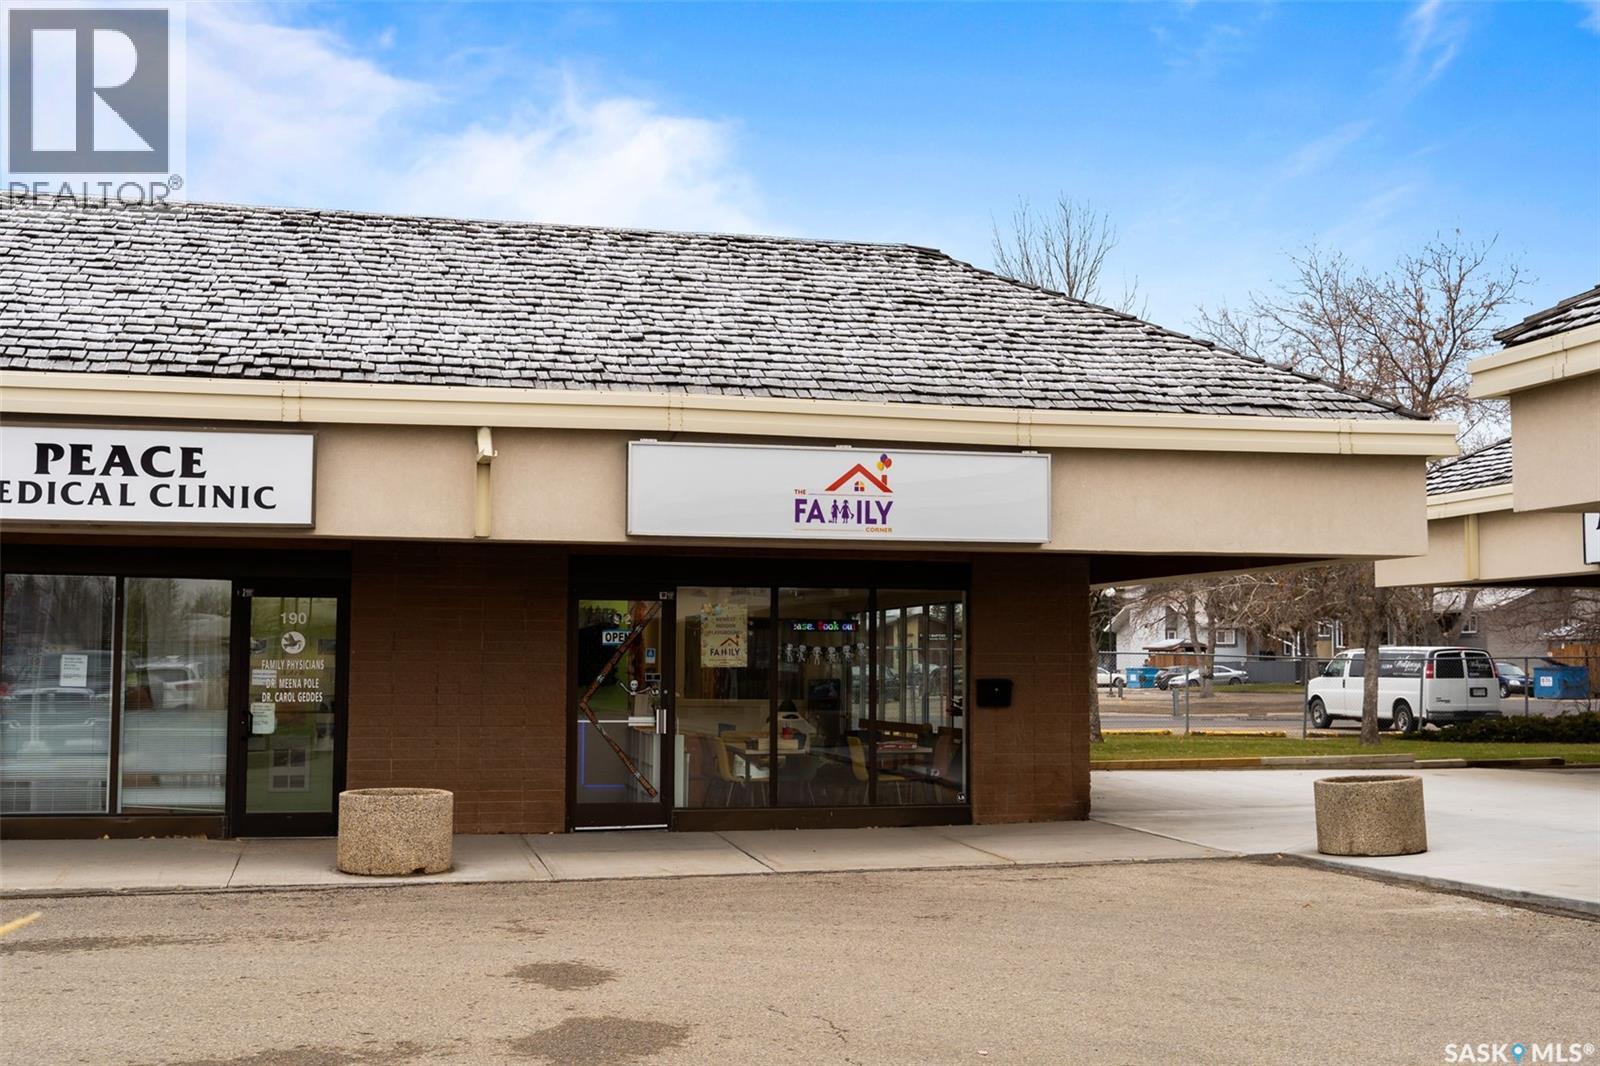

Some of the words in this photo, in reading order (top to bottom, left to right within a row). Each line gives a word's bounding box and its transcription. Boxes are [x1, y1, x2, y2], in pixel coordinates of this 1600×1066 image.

[34, 442, 207, 478] PEACE
[150, 483, 277, 509] CLINIC
[280, 612, 307, 625] 190
[261, 659, 285, 670] FAMILY
[287, 659, 325, 670] PHYSICIANS
[279, 678, 302, 689] MEENA
[303, 678, 320, 689] POLE
[274, 692, 296, 703] CAROL
[297, 692, 323, 703] GEDDES
